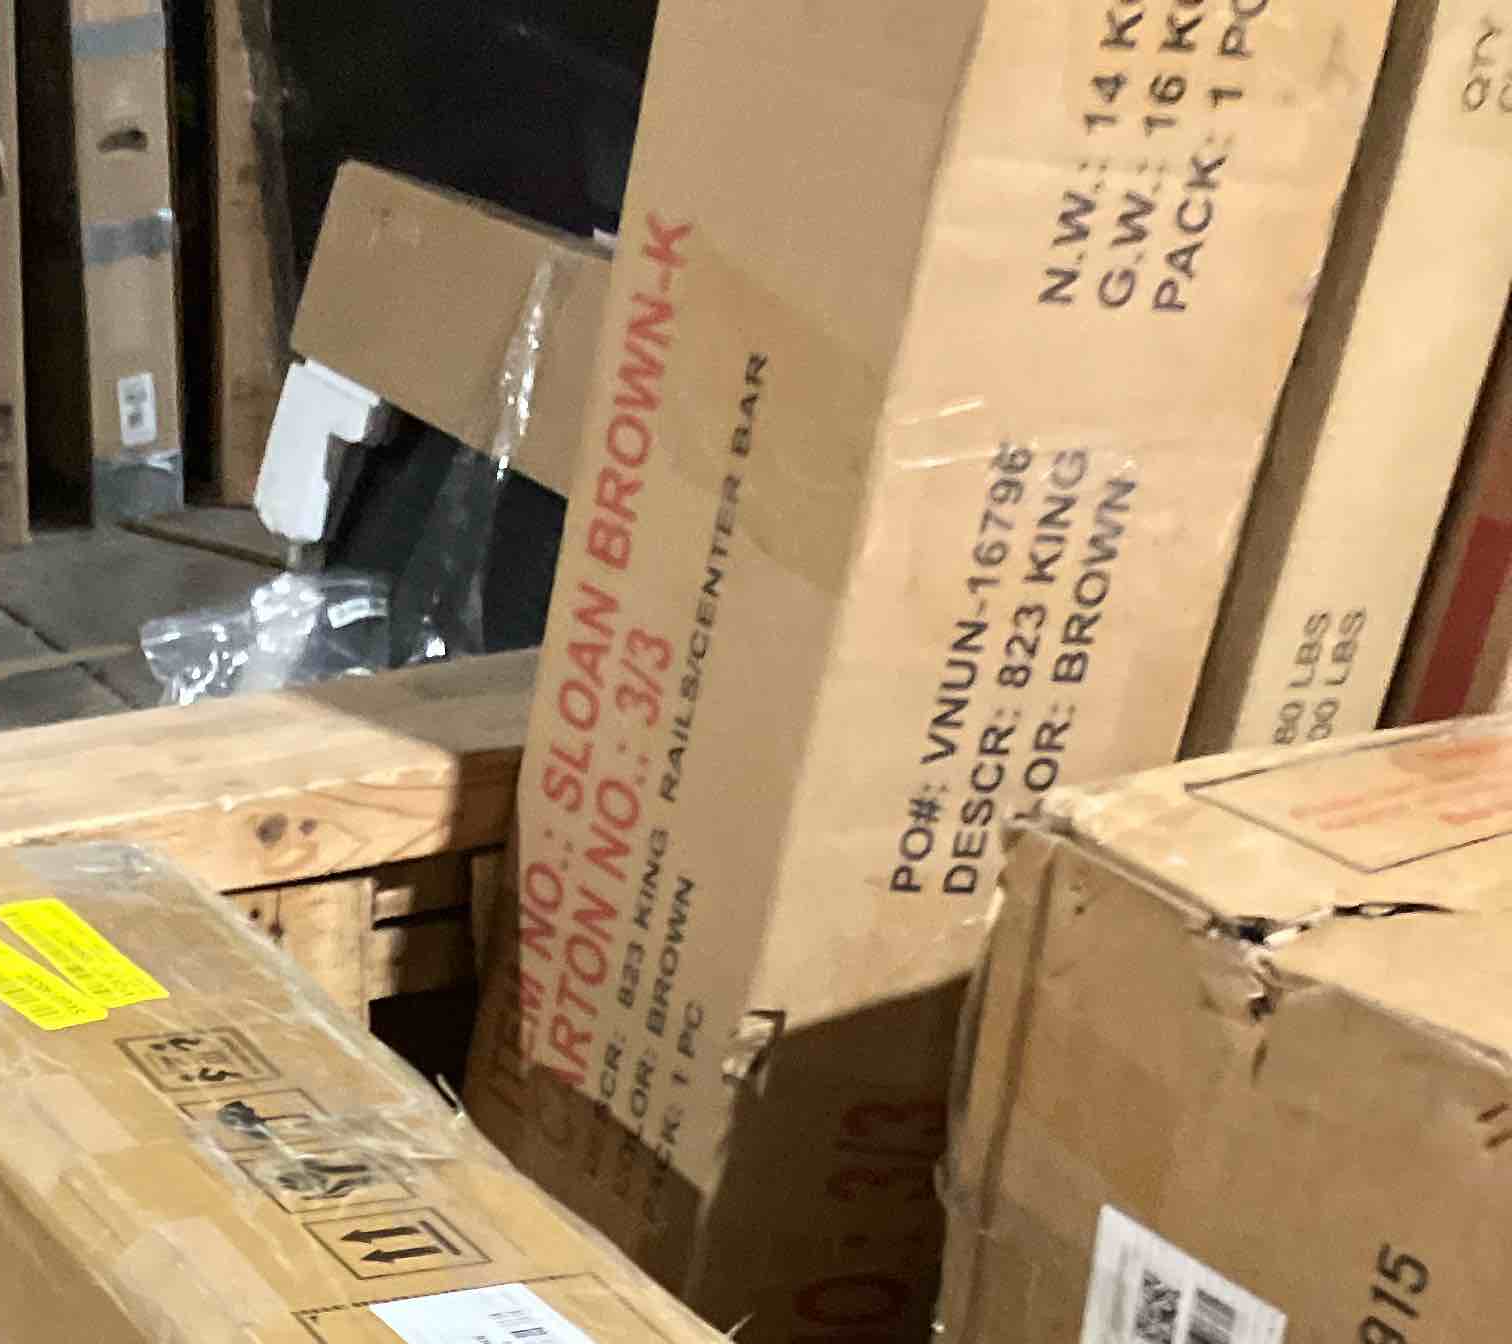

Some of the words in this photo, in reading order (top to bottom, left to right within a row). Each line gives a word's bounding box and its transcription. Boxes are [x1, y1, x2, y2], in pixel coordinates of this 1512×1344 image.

[1083, 72, 1129, 135] 14
[1143, 72, 1187, 137] 16
[1152, 133, 1234, 312] PACK:
[1208, 84, 1244, 108] 1
[730, 353, 769, 460] BAR
[541, 582, 620, 814] SLOAN
[585, 208, 694, 571] BROWN-K
[1022, 449, 1090, 584] KING
[1051, 476, 1138, 685] BROWN
[615, 627, 675, 728] 3/3
[889, 783, 949, 894] PO#:
[921, 440, 1034, 766] VNUN-16796
[997, 602, 1049, 690] 823
[1287, 611, 1331, 689] LBS
[1324, 607, 1368, 687] LBS
[943, 708, 1021, 896] DESCR:
[646, 874, 696, 1037] BROWN
